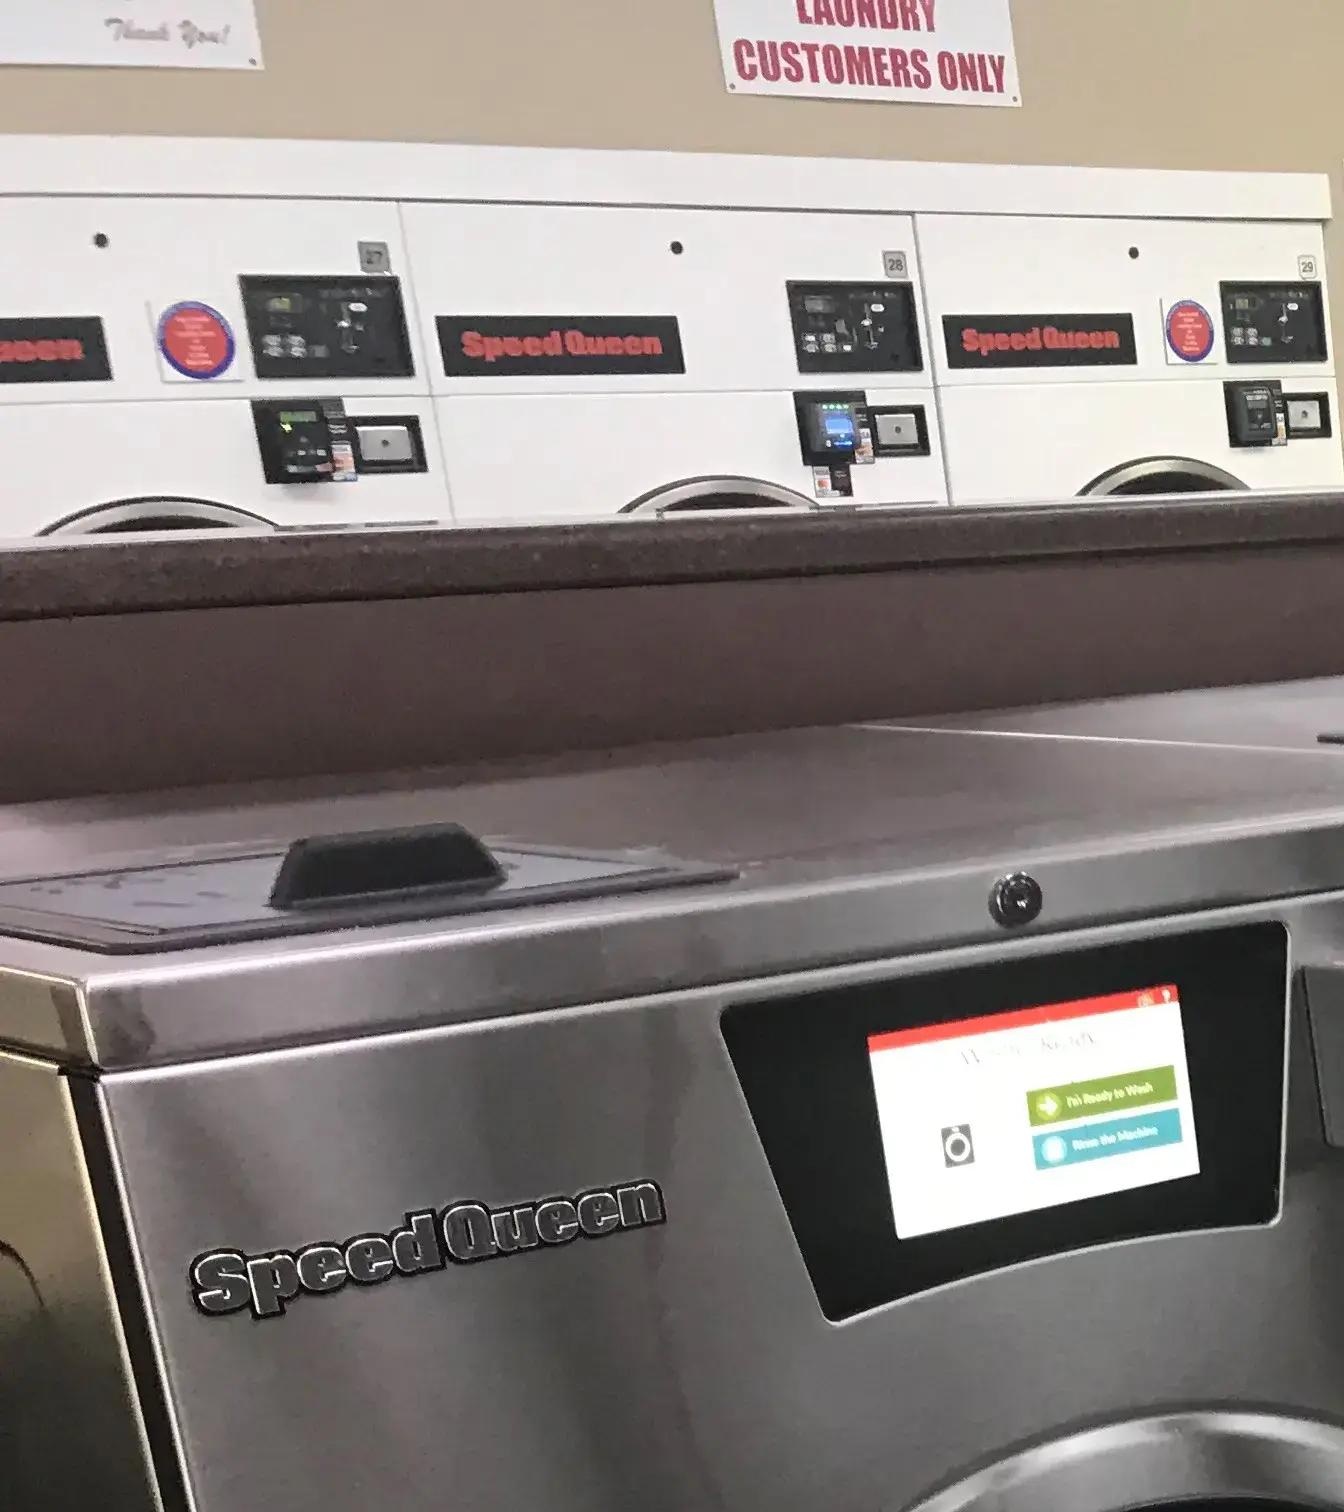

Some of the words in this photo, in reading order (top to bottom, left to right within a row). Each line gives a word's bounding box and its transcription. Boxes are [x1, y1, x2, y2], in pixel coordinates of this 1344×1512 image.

[795, 0, 935, 32] LAUNDRY
[733, 38, 932, 90] CUSTOMERS
[937, 50, 1005, 93] ONLY
[888, 258, 904, 272] 28
[1301, 261, 1314, 273] 29
[461, 331, 563, 362] Speed
[564, 330, 663, 355] Queen
[962, 327, 1043, 356] Speed
[1043, 326, 1120, 349] Queen
[1084, 1091, 1112, 1104] Ready
[1114, 1088, 1124, 1098] to
[1126, 1082, 1153, 1097] Wash
[1100, 1134, 1116, 1145] the
[190, 1208, 446, 1318] Speed
[440, 1180, 667, 1261] Queen
